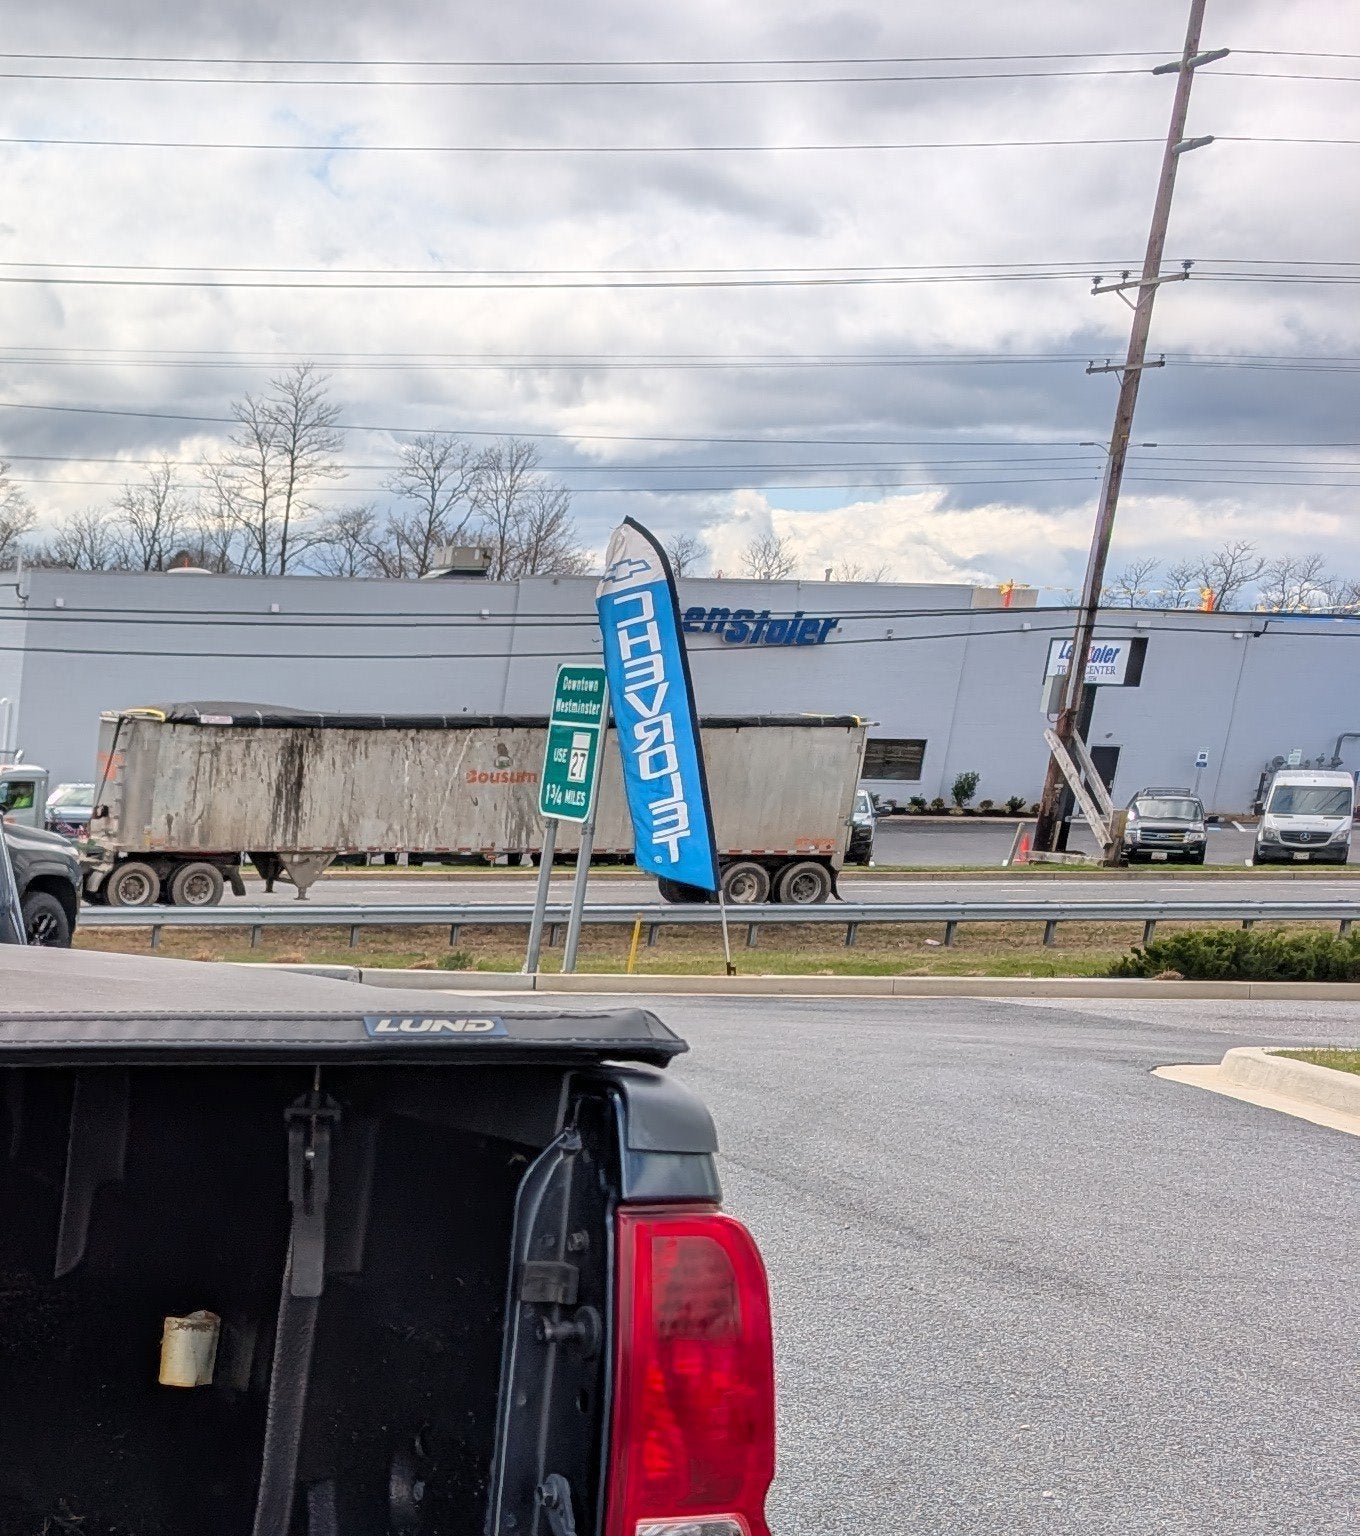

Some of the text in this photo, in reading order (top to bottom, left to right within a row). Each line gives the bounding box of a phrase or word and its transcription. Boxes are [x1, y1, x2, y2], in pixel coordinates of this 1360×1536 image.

[562, 676, 598, 692] Downtown
[555, 697, 601, 716] Westminster
[553, 748, 587, 778] USE 27
[564, 789, 586, 806] MILES
[375, 1019, 496, 1033] LUND
